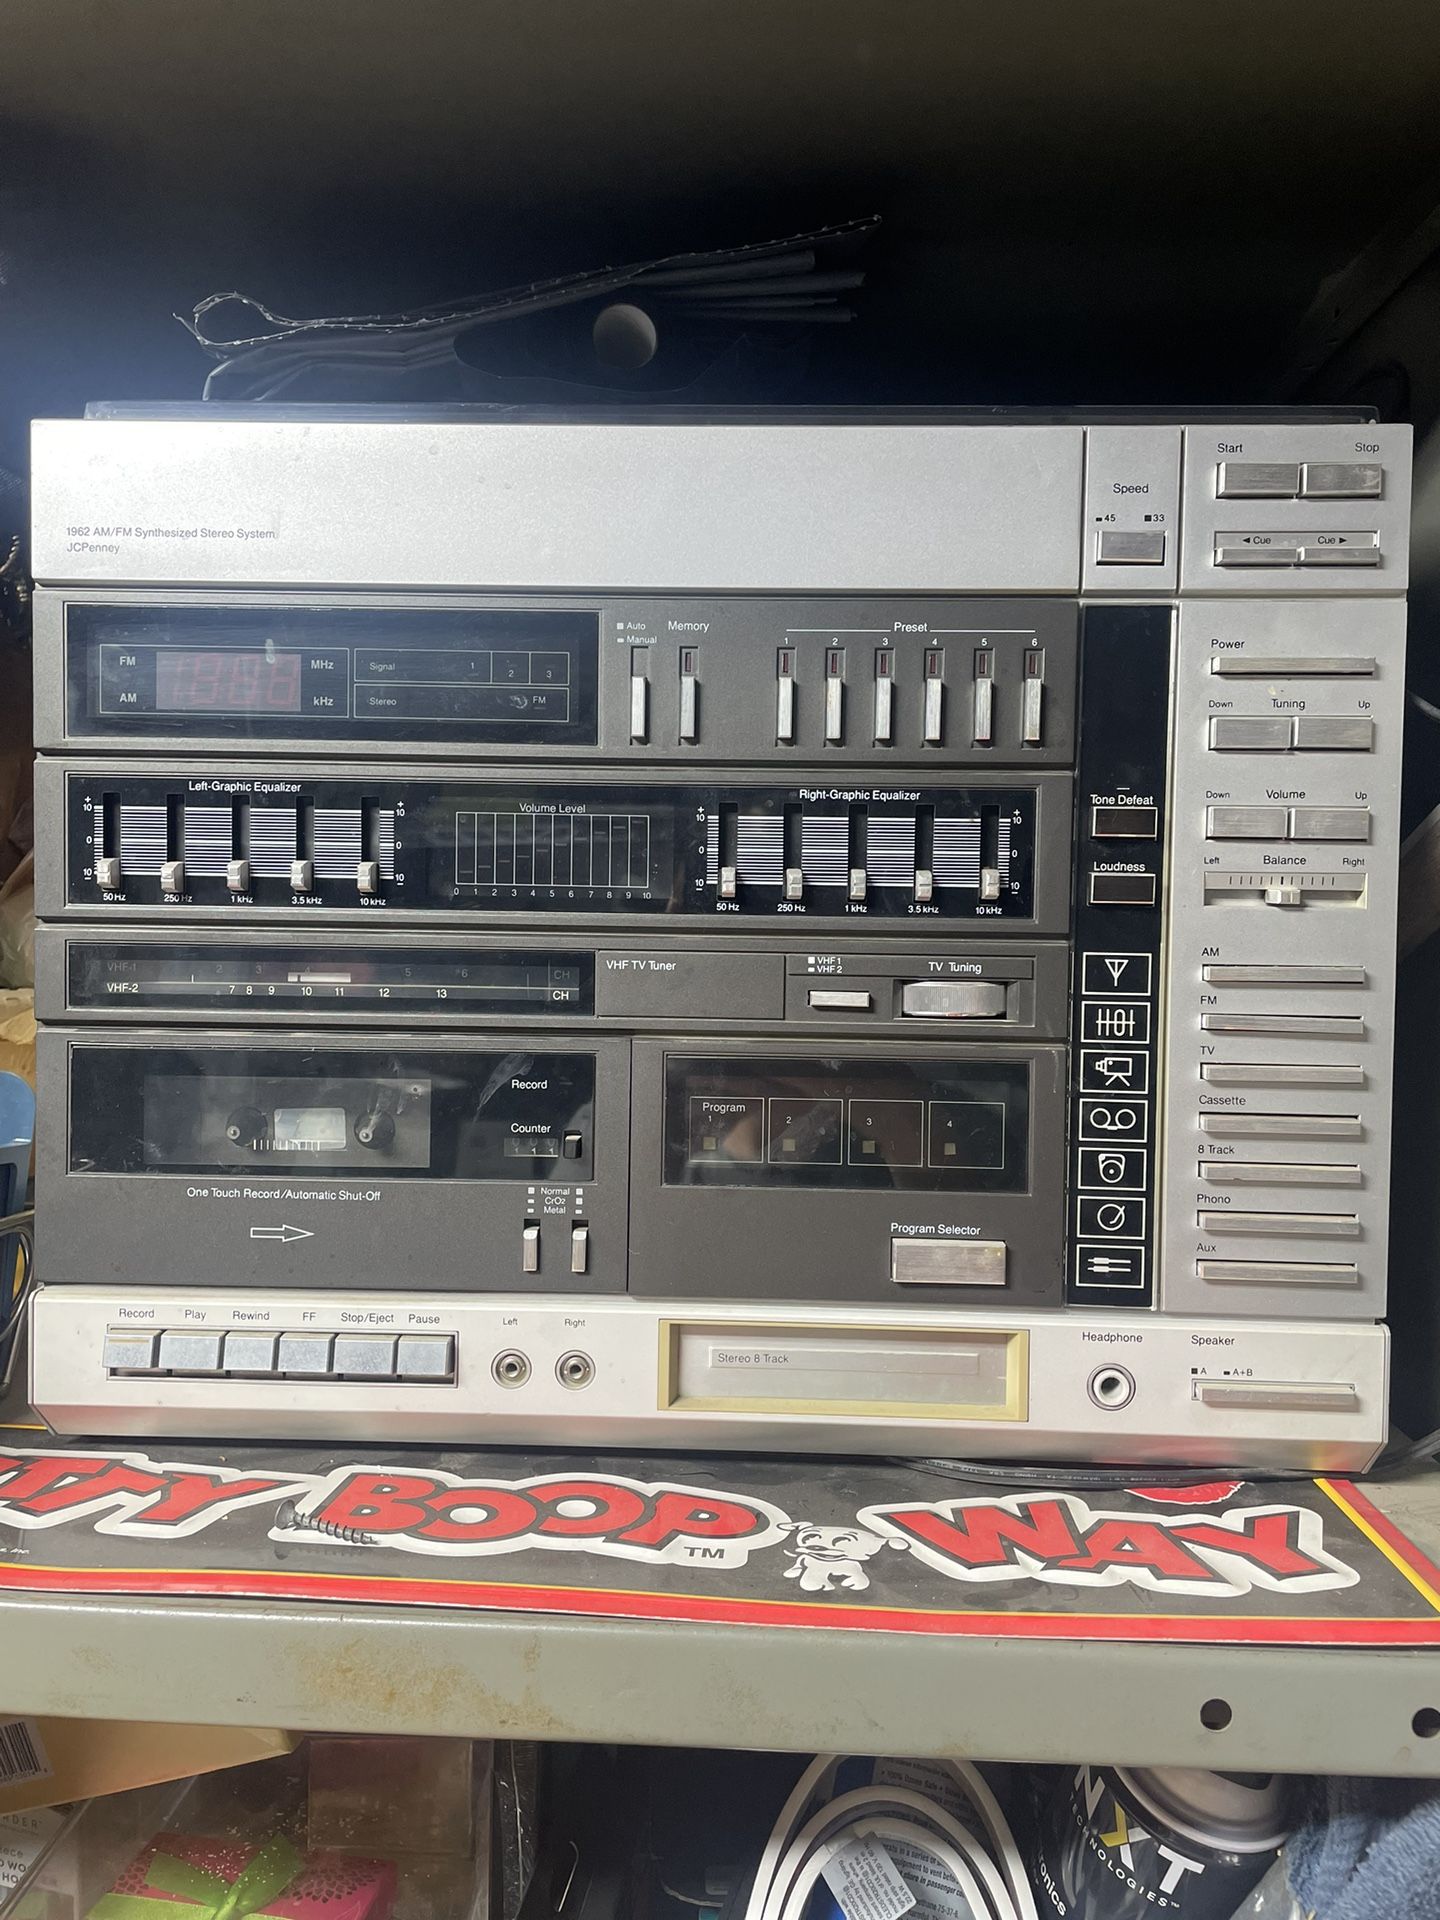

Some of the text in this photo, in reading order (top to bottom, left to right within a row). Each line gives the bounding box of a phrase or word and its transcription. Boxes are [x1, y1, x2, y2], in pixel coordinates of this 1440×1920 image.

[1218, 443, 1242, 453] Start
[1355, 442, 1379, 454] Stop
[1113, 483, 1148, 494] Speed
[1105, 514, 1116, 522] 45
[1153, 514, 1164, 522] 33
[66, 527, 275, 540] 1962 AM/FM Synthesized Stereo System
[1253, 536, 1271, 544] Cue
[1318, 536, 1335, 544] Cue
[67, 542, 120, 555] JCPenney
[627, 622, 646, 630] Auto
[668, 621, 709, 633] Memory
[894, 622, 927, 632] Preset
[627, 635, 657, 643] Manual
[883, 637, 888, 646] 3
[982, 638, 987, 646] 5
[1032, 638, 1037, 646] 6
[1211, 639, 1245, 649] Power
[120, 656, 135, 665] FM
[311, 660, 334, 669] MHz
[370, 662, 395, 672] Signal
[547, 670, 552, 678] 3
[120, 693, 136, 702] AM
[314, 696, 333, 706] kHz
[369, 697, 397, 705] Stereo
[1209, 700, 1233, 708] Down
[1272, 699, 1305, 711] Tuning
[1358, 701, 1370, 709] Up
[189, 781, 301, 793] Left-Graphic Equalizer
[800, 789, 920, 802] Right-Graphic Equalizer
[1266, 790, 1305, 799] Volume
[1355, 792, 1367, 800] Up
[1090, 794, 1153, 805] Tone Defeat
[519, 803, 585, 813] Volume Level
[1264, 855, 1306, 865] Balance
[1343, 858, 1364, 867] Right
[1094, 862, 1145, 871] Loudness
[103, 893, 113, 901] 50
[164, 894, 179, 902] 250
[626, 891, 631, 899] 9
[292, 896, 305, 904] 3.5
[717, 903, 739, 911] 50 Hz
[777, 904, 805, 912] 250 Hz
[908, 905, 921, 913] 3.5
[1202, 947, 1219, 956] AM
[606, 960, 676, 970] VHF TV Tuner
[817, 965, 835, 973] VHF
[928, 962, 981, 974] TV Tuning
[107, 983, 138, 993] VHF-2
[229, 985, 447, 998] 7 8 9 10 11 12 13
[553, 991, 569, 1000] CH
[1201, 996, 1216, 1004] FM
[1200, 1046, 1215, 1055] TV
[512, 1079, 547, 1089] Record
[1199, 1095, 1246, 1105] Cassette
[703, 1102, 745, 1114] Program
[786, 1116, 791, 1124] 2
[511, 1123, 551, 1133] Counter
[1198, 1145, 1234, 1154] 8 Track
[187, 1187, 208, 1197] One
[211, 1188, 240, 1197] Touch
[339, 1190, 380, 1201] Shut-Off
[541, 1187, 570, 1195] Normal
[1197, 1194, 1231, 1204] Phono
[544, 1206, 566, 1214] Metal
[891, 1223, 981, 1235] Program Selector
[1197, 1243, 1216, 1252] Aux
[119, 1308, 154, 1318] Record
[185, 1309, 206, 1321] Play
[233, 1311, 269, 1320] Rewind
[303, 1312, 316, 1321] FF
[341, 1312, 394, 1324] Stop/Eject
[409, 1314, 440, 1324] Pause
[565, 1319, 585, 1328] Right
[1083, 1332, 1143, 1343] Headphone
[1191, 1335, 1235, 1346] Speaker
[718, 1353, 789, 1363] Stereo 8 Track
[1233, 1368, 1253, 1376] A+B
[316, 1471, 763, 1549] BOOP
[684, 1546, 725, 1559] TM
[888, 1498, 1320, 1578] WAY
